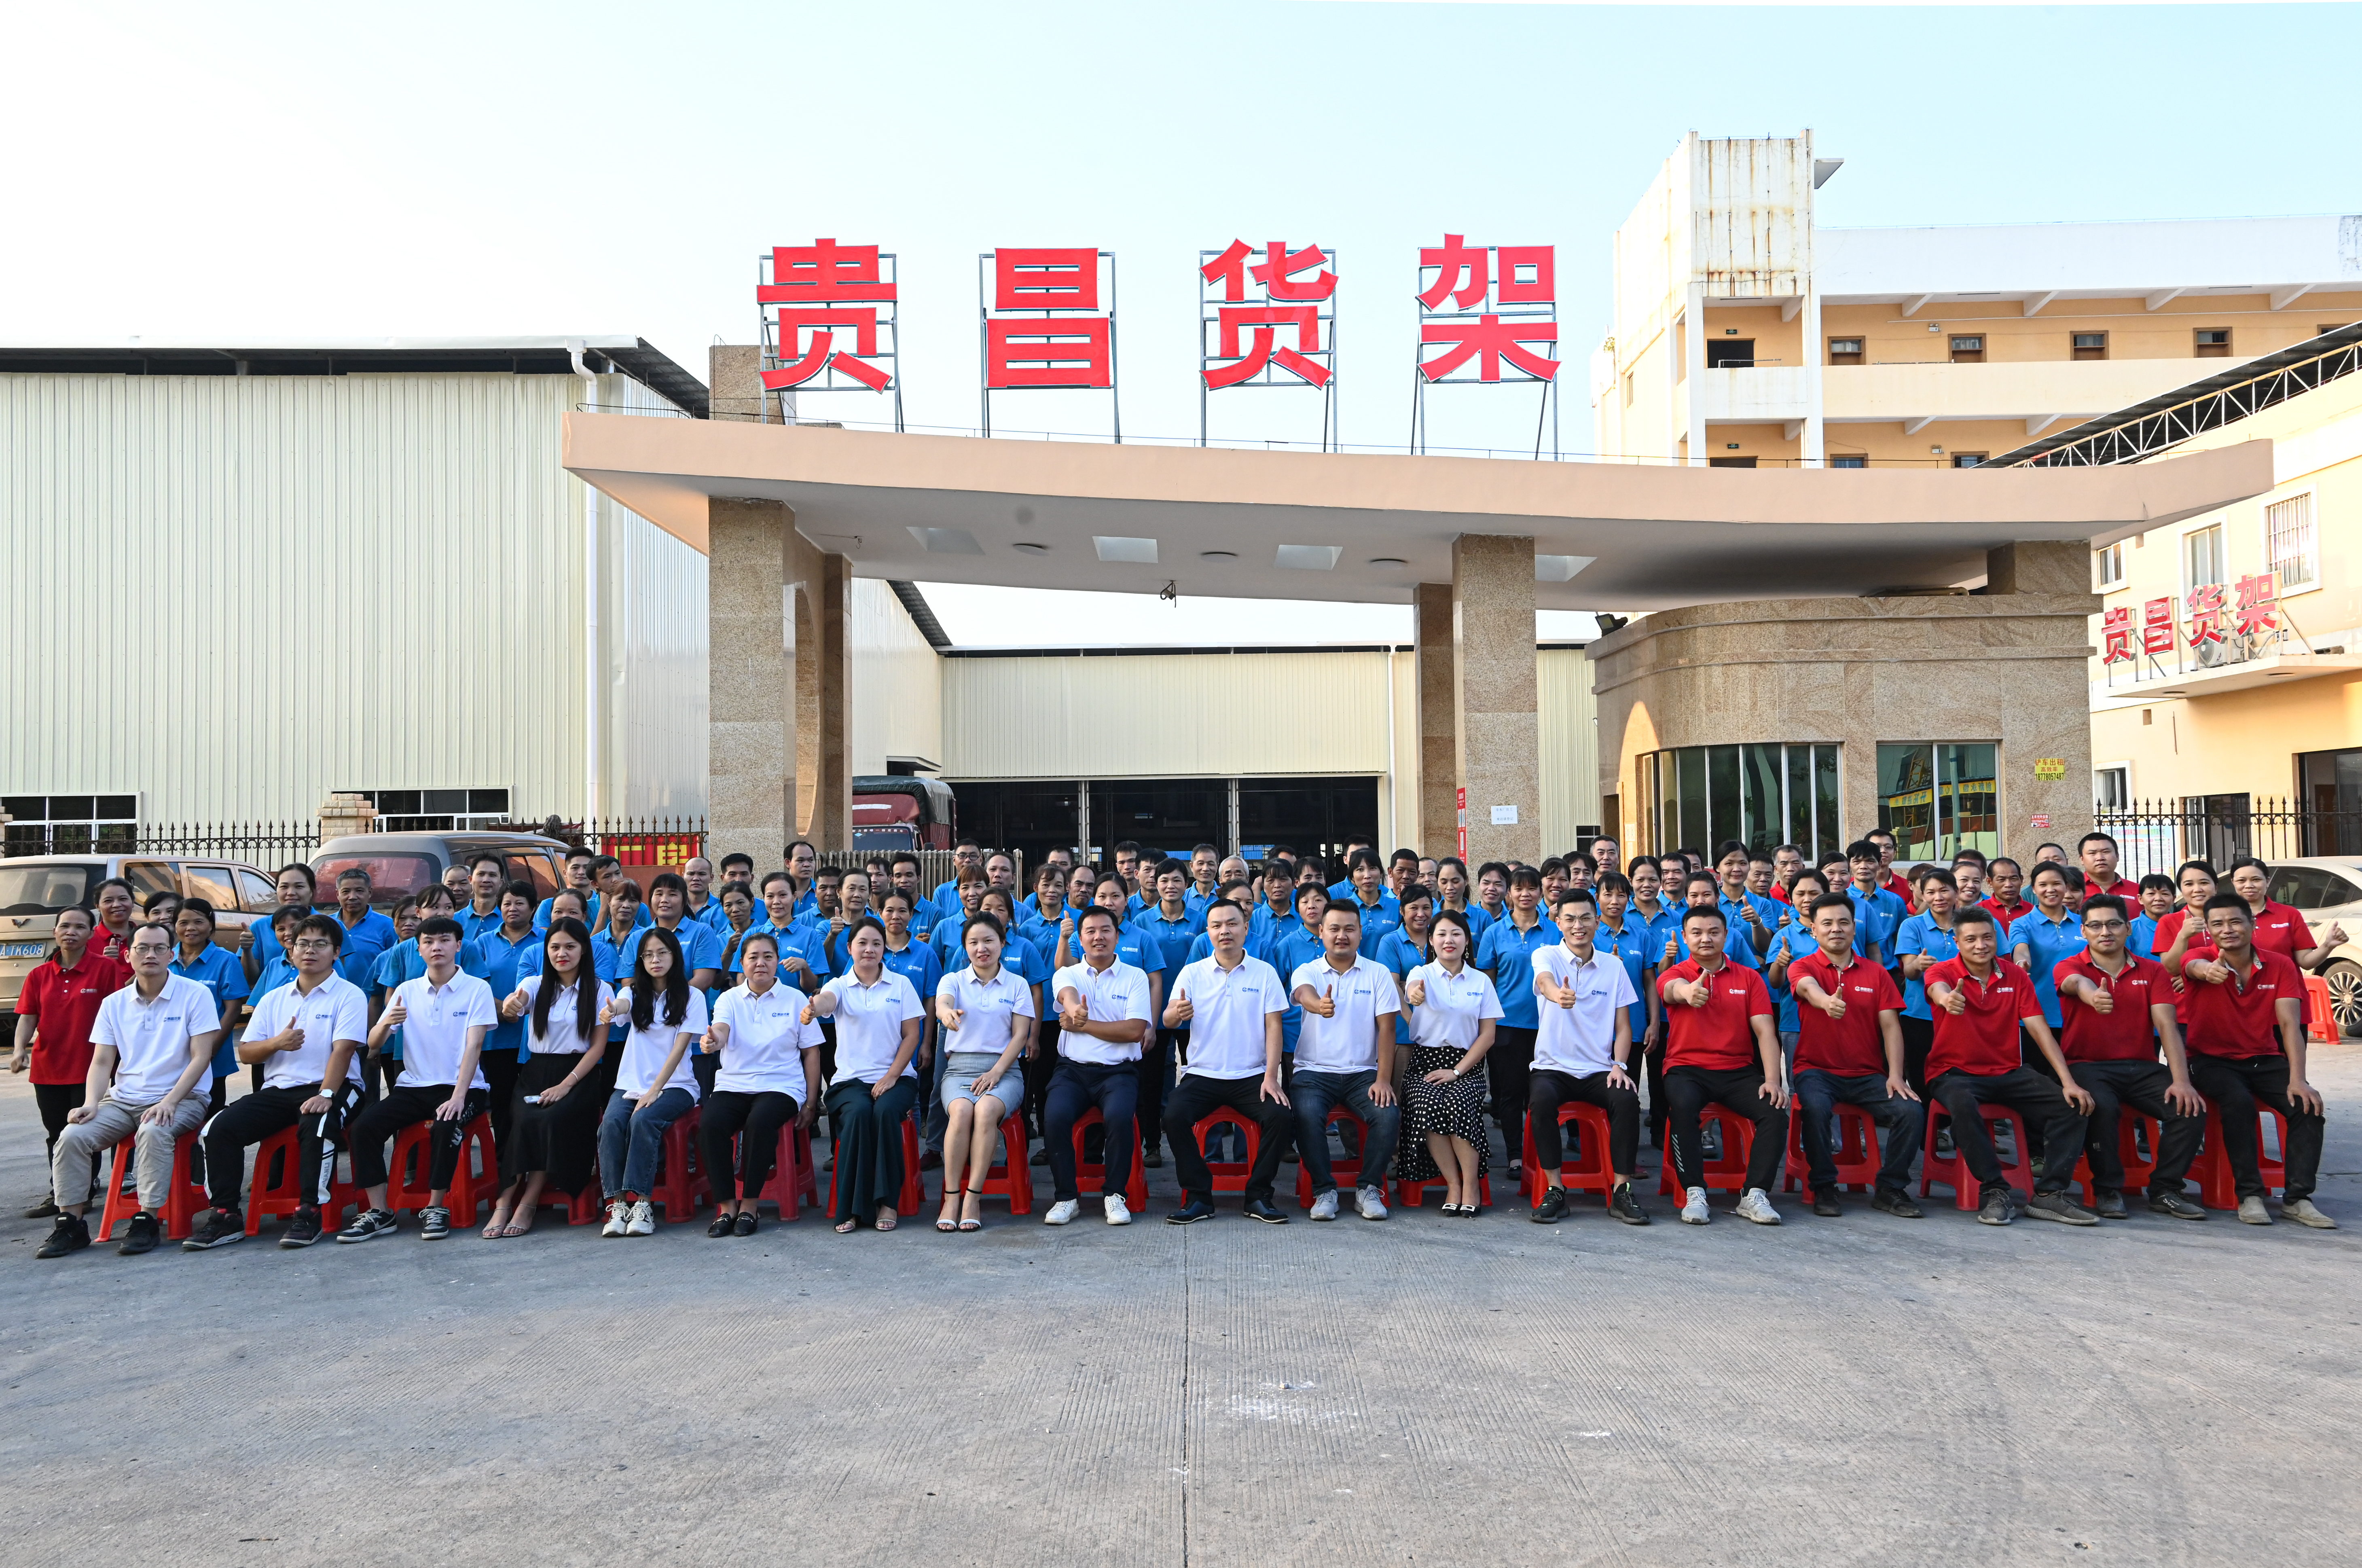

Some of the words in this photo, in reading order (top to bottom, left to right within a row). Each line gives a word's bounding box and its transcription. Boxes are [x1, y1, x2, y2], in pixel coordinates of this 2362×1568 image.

[757, 233, 1562, 394] 贵昌货架
[2102, 573, 2277, 665] 贵昌货架
